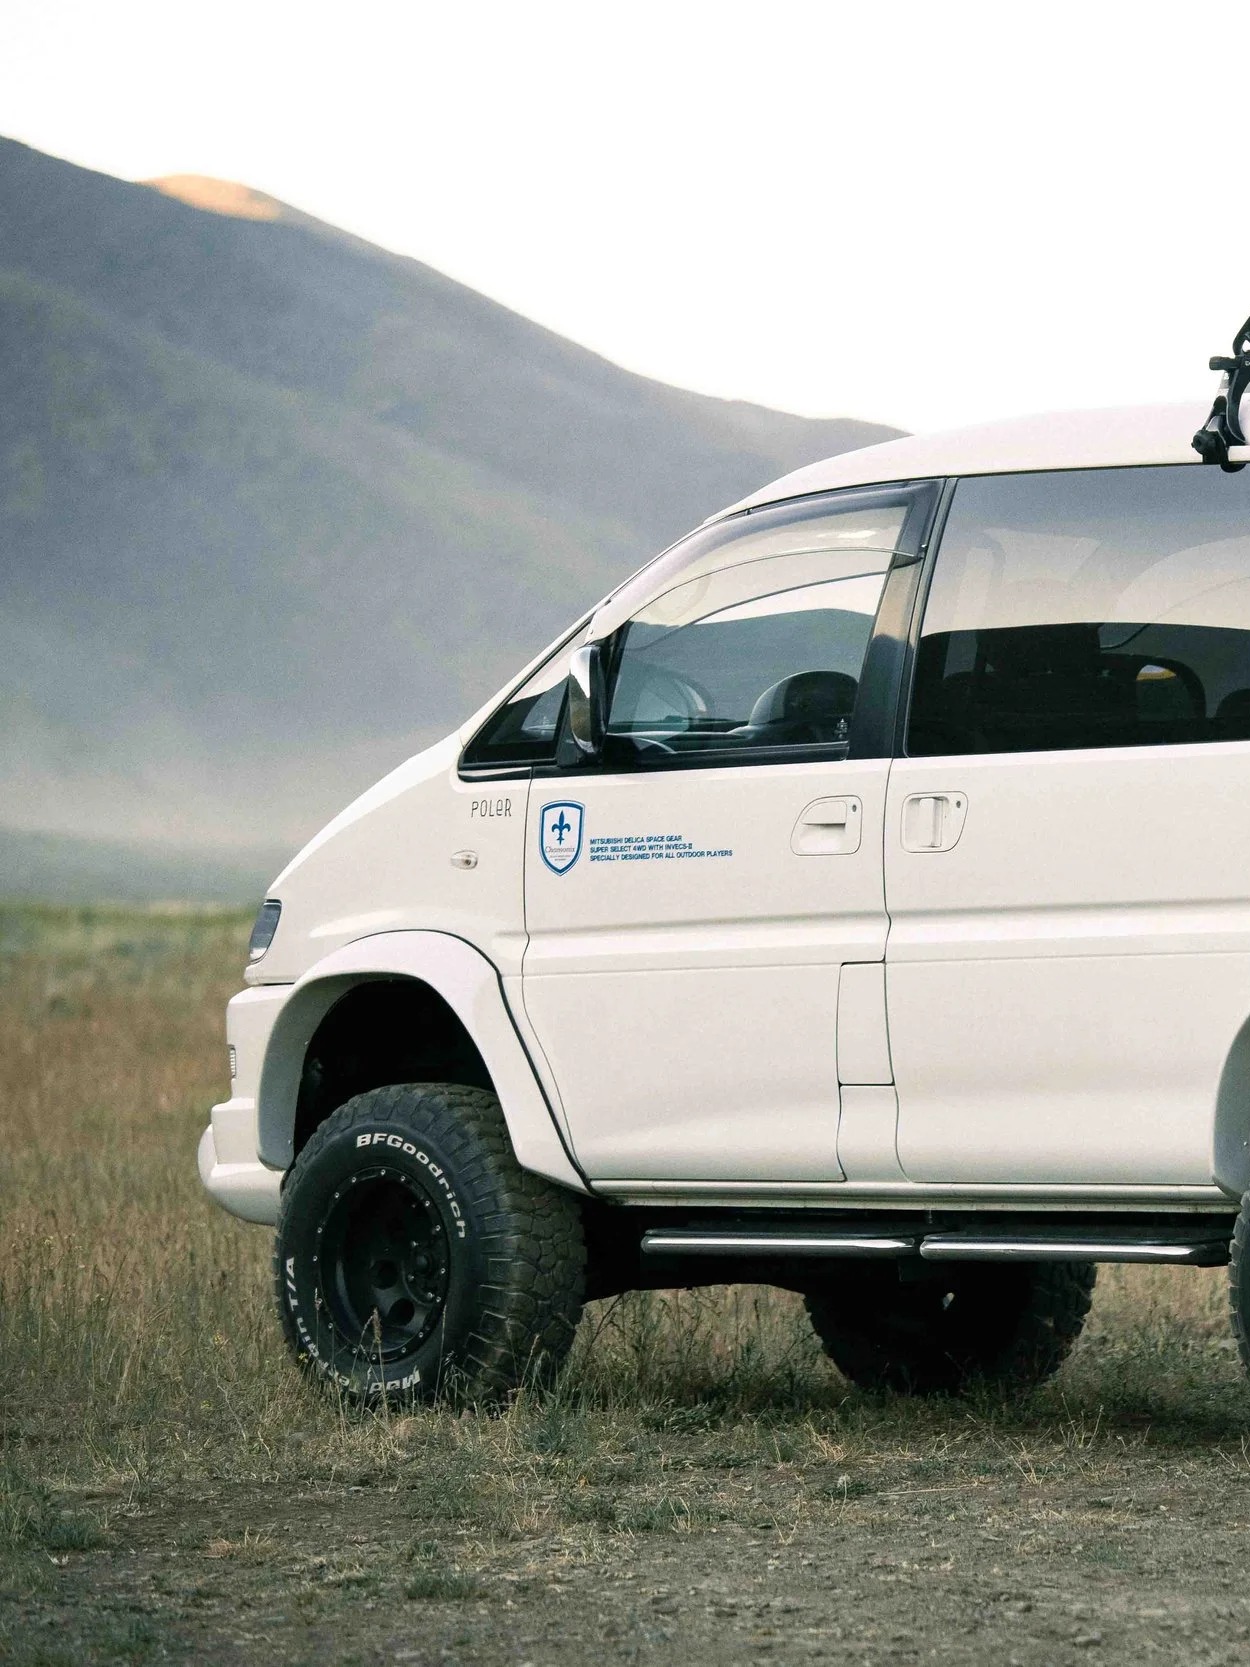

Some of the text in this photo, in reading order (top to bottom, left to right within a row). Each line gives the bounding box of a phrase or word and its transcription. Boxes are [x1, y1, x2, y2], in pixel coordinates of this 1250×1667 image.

[620, 853, 651, 861] DESIGNED
[651, 852, 664, 860] FOR
[664, 851, 676, 859] ALL
[676, 850, 706, 859] OUTDOOR
[706, 849, 733, 857] PLAYERS
[624, 836, 645, 844] DELICA
[645, 835, 665, 843] SPACE
[665, 834, 683, 842] GEAR
[355, 1132, 467, 1239] BFGoodrich
[285, 1256, 299, 1312] T/A
